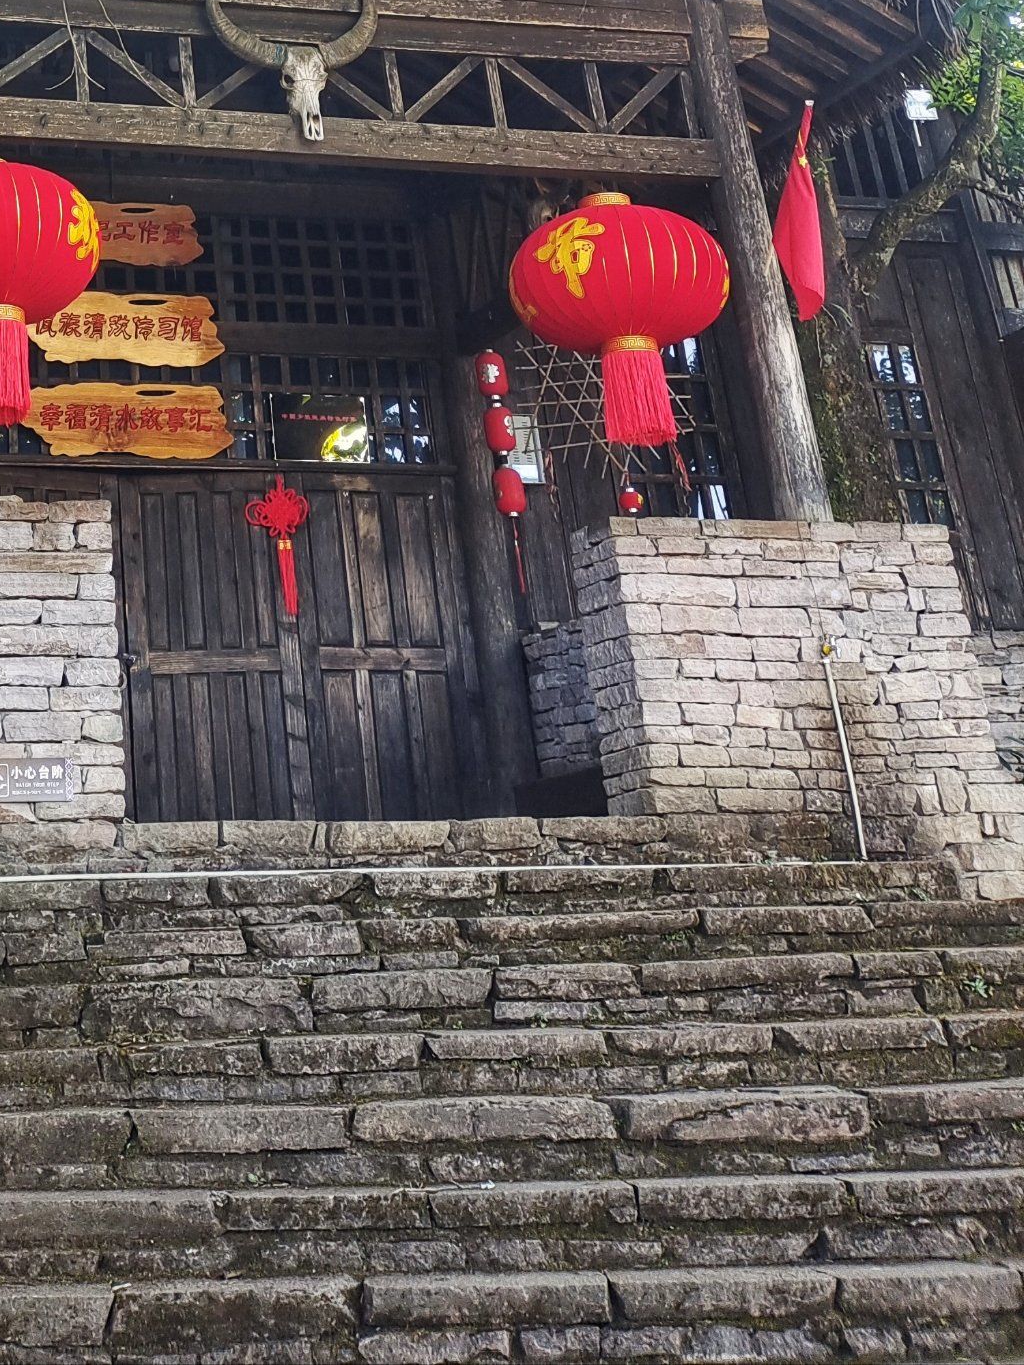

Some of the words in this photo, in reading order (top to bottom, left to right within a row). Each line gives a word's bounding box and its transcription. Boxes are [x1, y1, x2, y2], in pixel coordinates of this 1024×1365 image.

[40, 403, 213, 433] 幸福清水故事汇
[10, 764, 64, 780] 小心台阶
